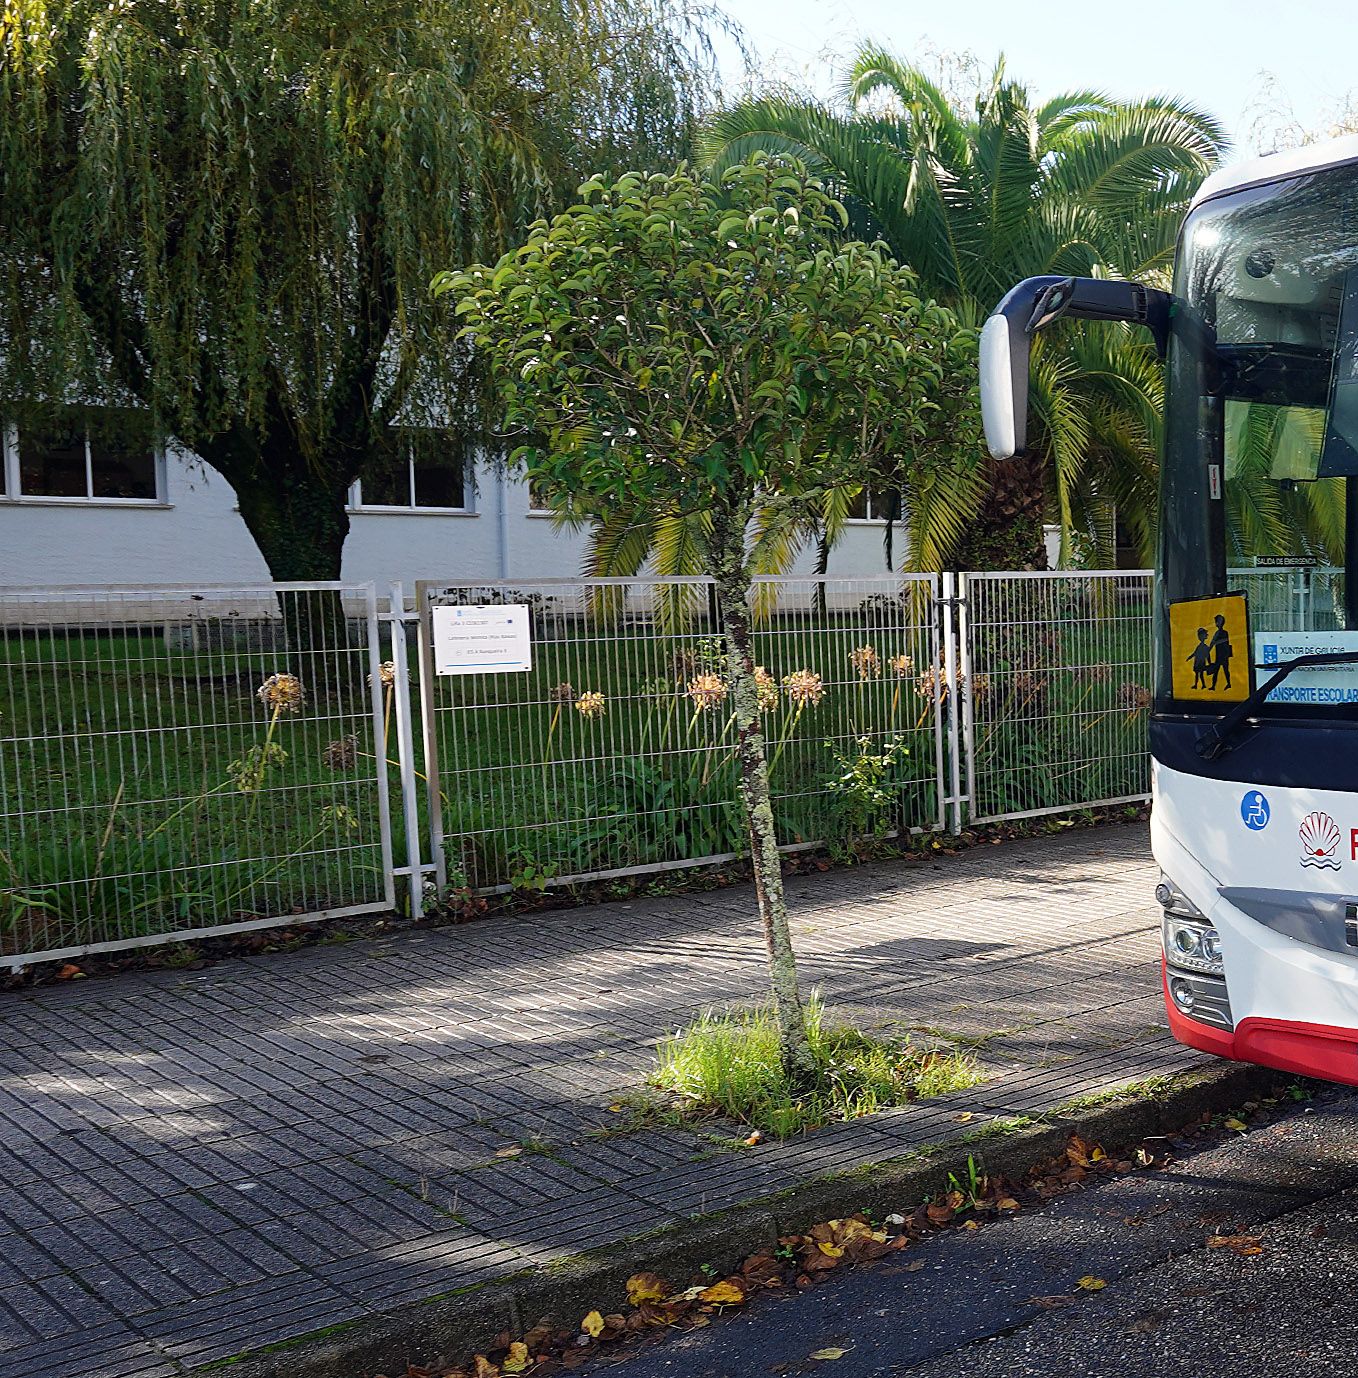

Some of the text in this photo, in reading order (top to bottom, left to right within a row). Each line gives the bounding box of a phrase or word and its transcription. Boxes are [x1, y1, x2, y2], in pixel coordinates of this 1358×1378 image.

[1280, 646, 1303, 655] XUNTA
[1305, 646, 1314, 655] DE
[1267, 687, 1358, 702] RANSPORTE ESCOLAR
